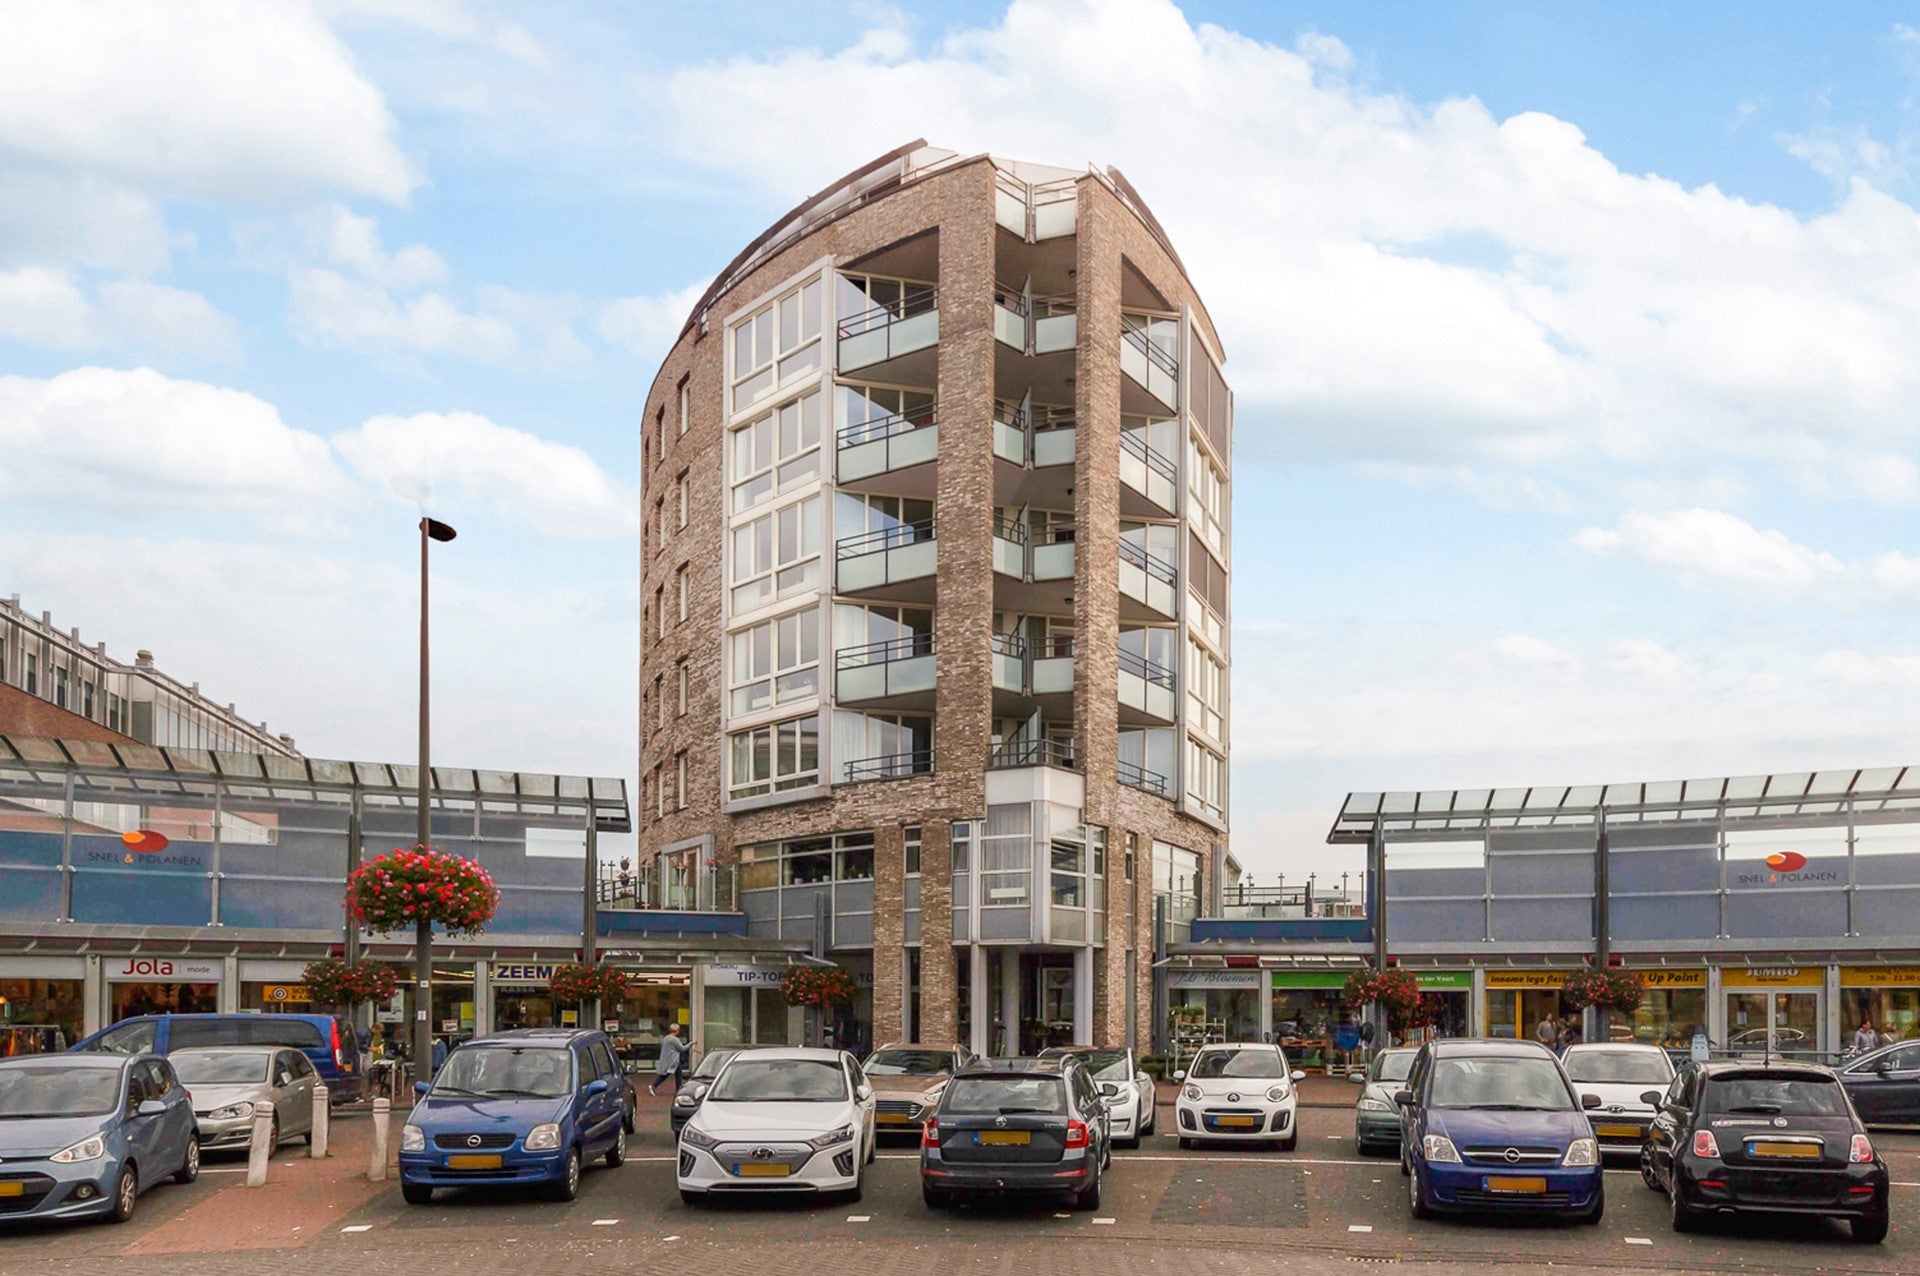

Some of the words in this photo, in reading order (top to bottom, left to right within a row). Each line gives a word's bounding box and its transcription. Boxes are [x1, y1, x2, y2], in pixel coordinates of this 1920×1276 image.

[88, 851, 120, 864] SNEL
[124, 853, 134, 864] &
[138, 854, 201, 865] POLANEN
[1739, 874, 1764, 883] SNEL
[1769, 874, 1777, 884] &
[1781, 873, 1837, 882] POLANEN
[122, 958, 173, 975] Jola
[497, 965, 558, 979] ZEEM
[1648, 973, 1664, 985] Up
[1667, 972, 1699, 982] Point
